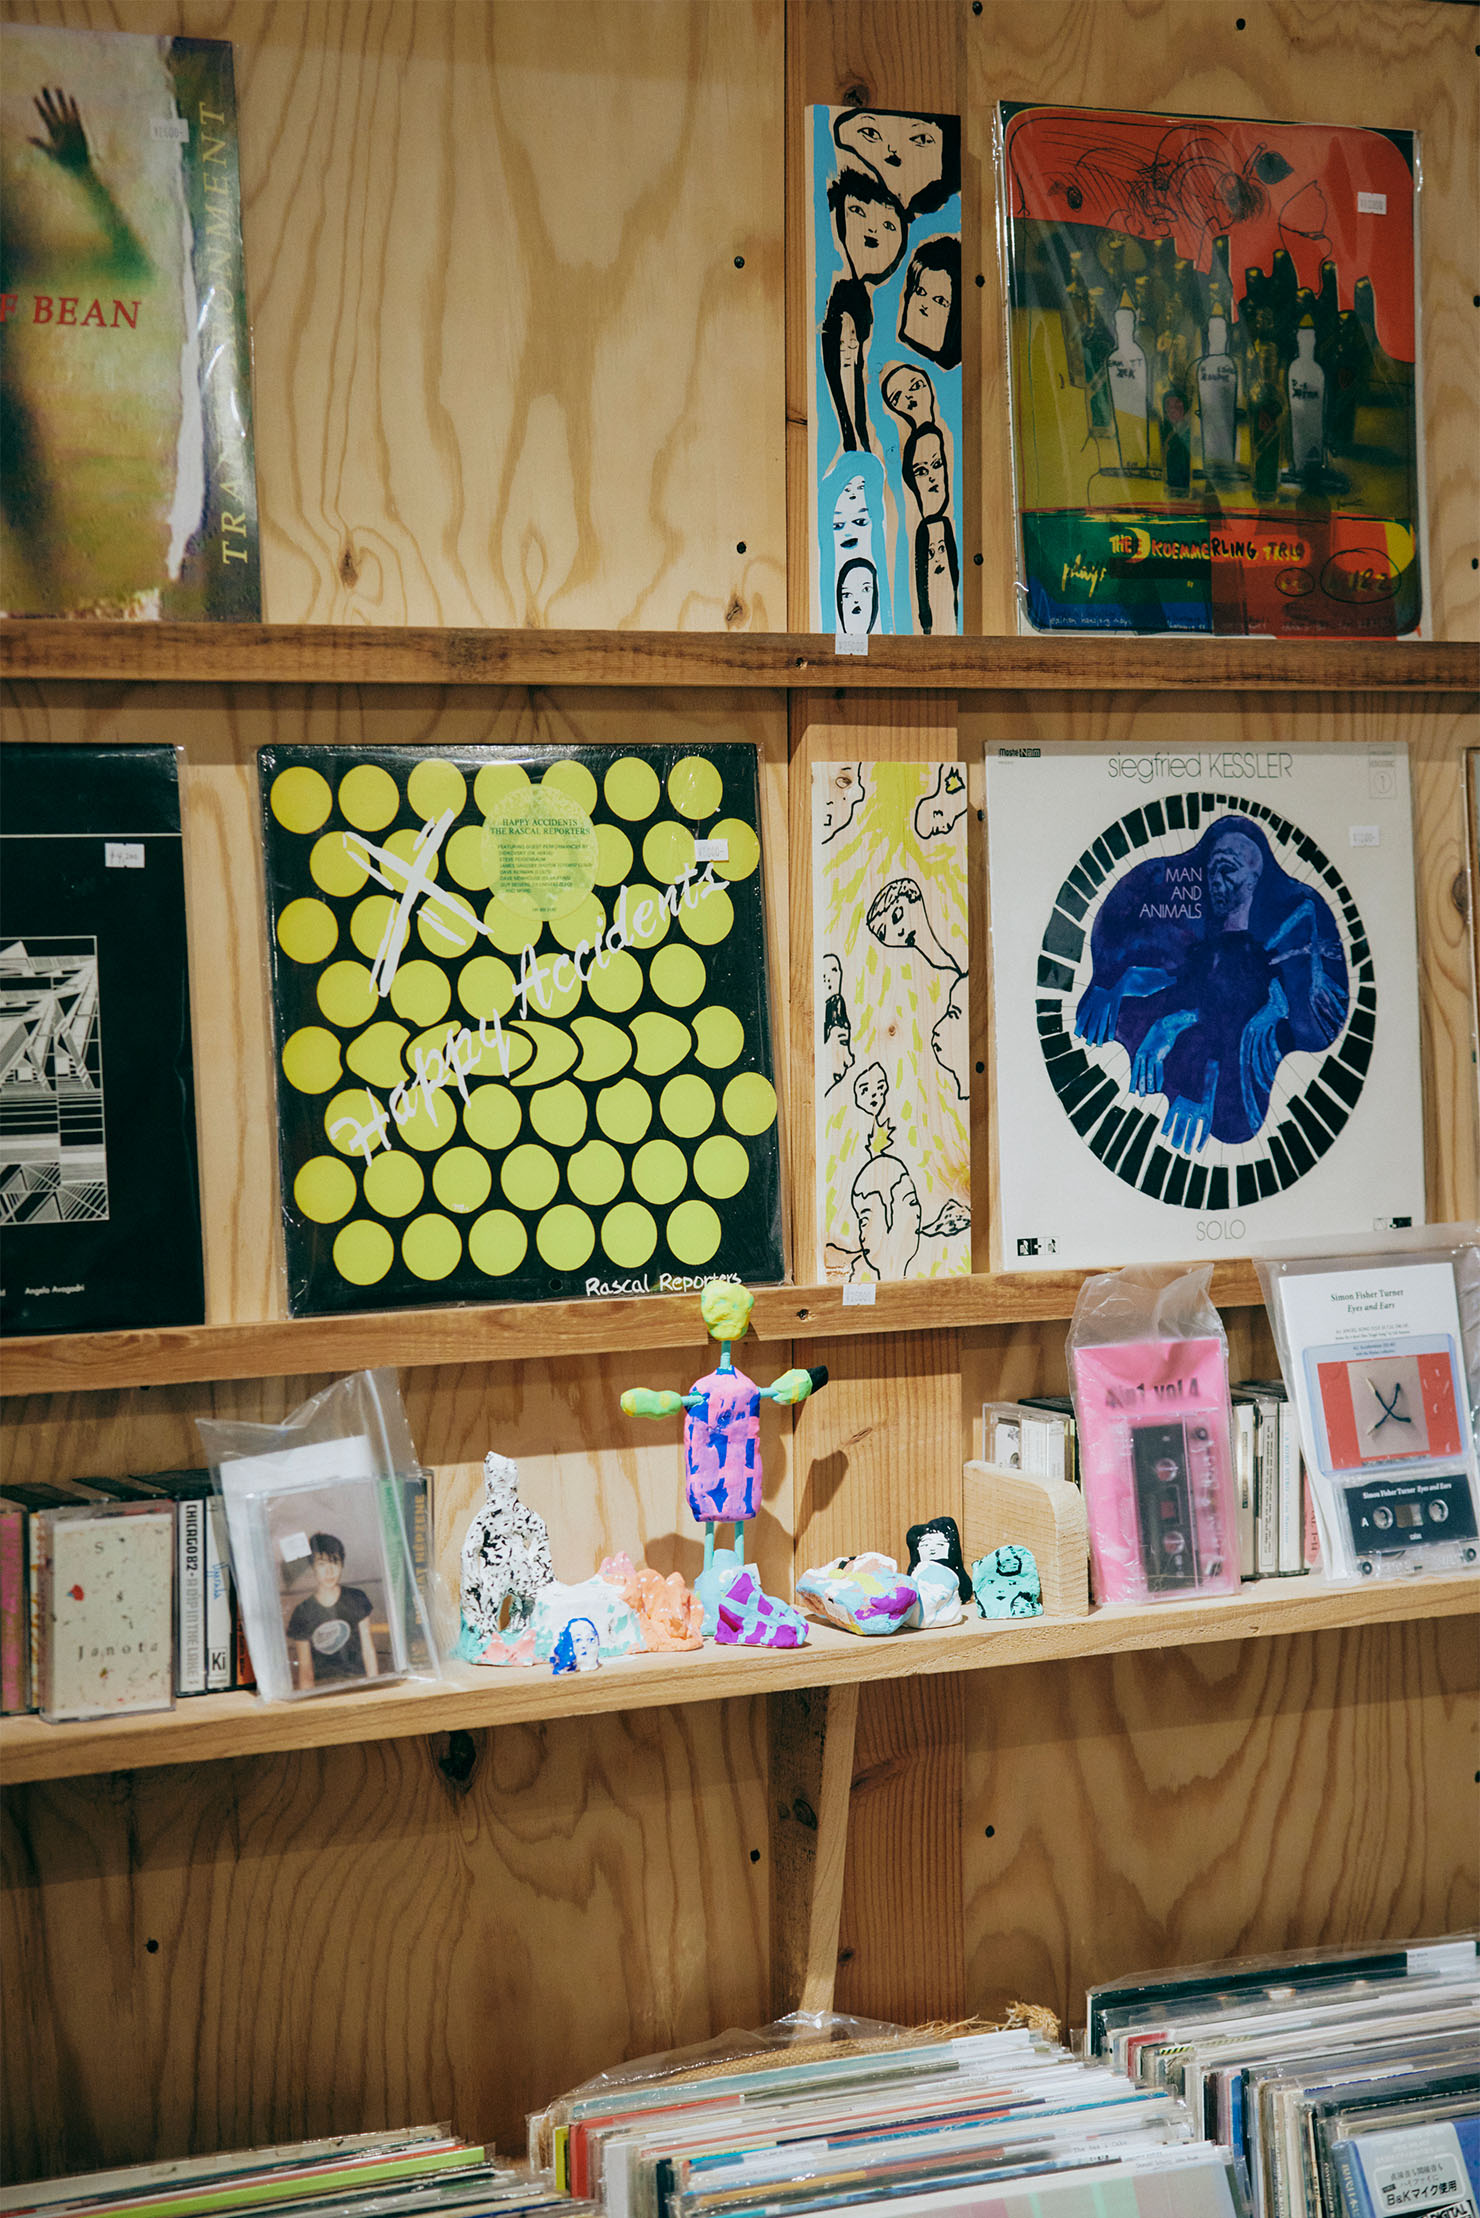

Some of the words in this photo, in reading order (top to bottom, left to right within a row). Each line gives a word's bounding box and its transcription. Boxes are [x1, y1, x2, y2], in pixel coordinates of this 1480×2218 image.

[32, 295, 142, 330] BEAN
[1107, 752, 1203, 783] siegfried
[1207, 752, 1295, 778] KESSLER
[490, 827, 507, 835] THE
[508, 827, 541, 835] RASCAL
[543, 827, 591, 835] REPORTERS
[502, 818, 529, 826] HAPPY
[532, 818, 578, 826] ACCIDENTS
[1165, 867, 1203, 884] MAN
[1170, 885, 1203, 902] AND
[1139, 902, 1203, 920] ANIMALS
[328, 1007, 514, 1168] Happy
[510, 860, 732, 1022] Accidents
[1195, 1219, 1247, 1242] SOLO
[584, 1273, 650, 1297] Rascal
[1330, 1293, 1354, 1302] Simon
[1355, 1290, 1377, 1299] Fisher
[1378, 1288, 1404, 1298] Turner
[1347, 1303, 1363, 1314] Eyes
[1364, 1302, 1378, 1311] and
[1379, 1301, 1396, 1310] Ears
[1397, 1486, 1416, 1495] Turner
[186, 1504, 198, 1554] CHICAGO
[1361, 1517, 1370, 1528] A
[187, 1556, 199, 1571] 82
[78, 1640, 159, 1660] Janota
[211, 1650, 227, 1671] Ki
[1387, 2180, 1458, 2206] B&Kマイク使用
